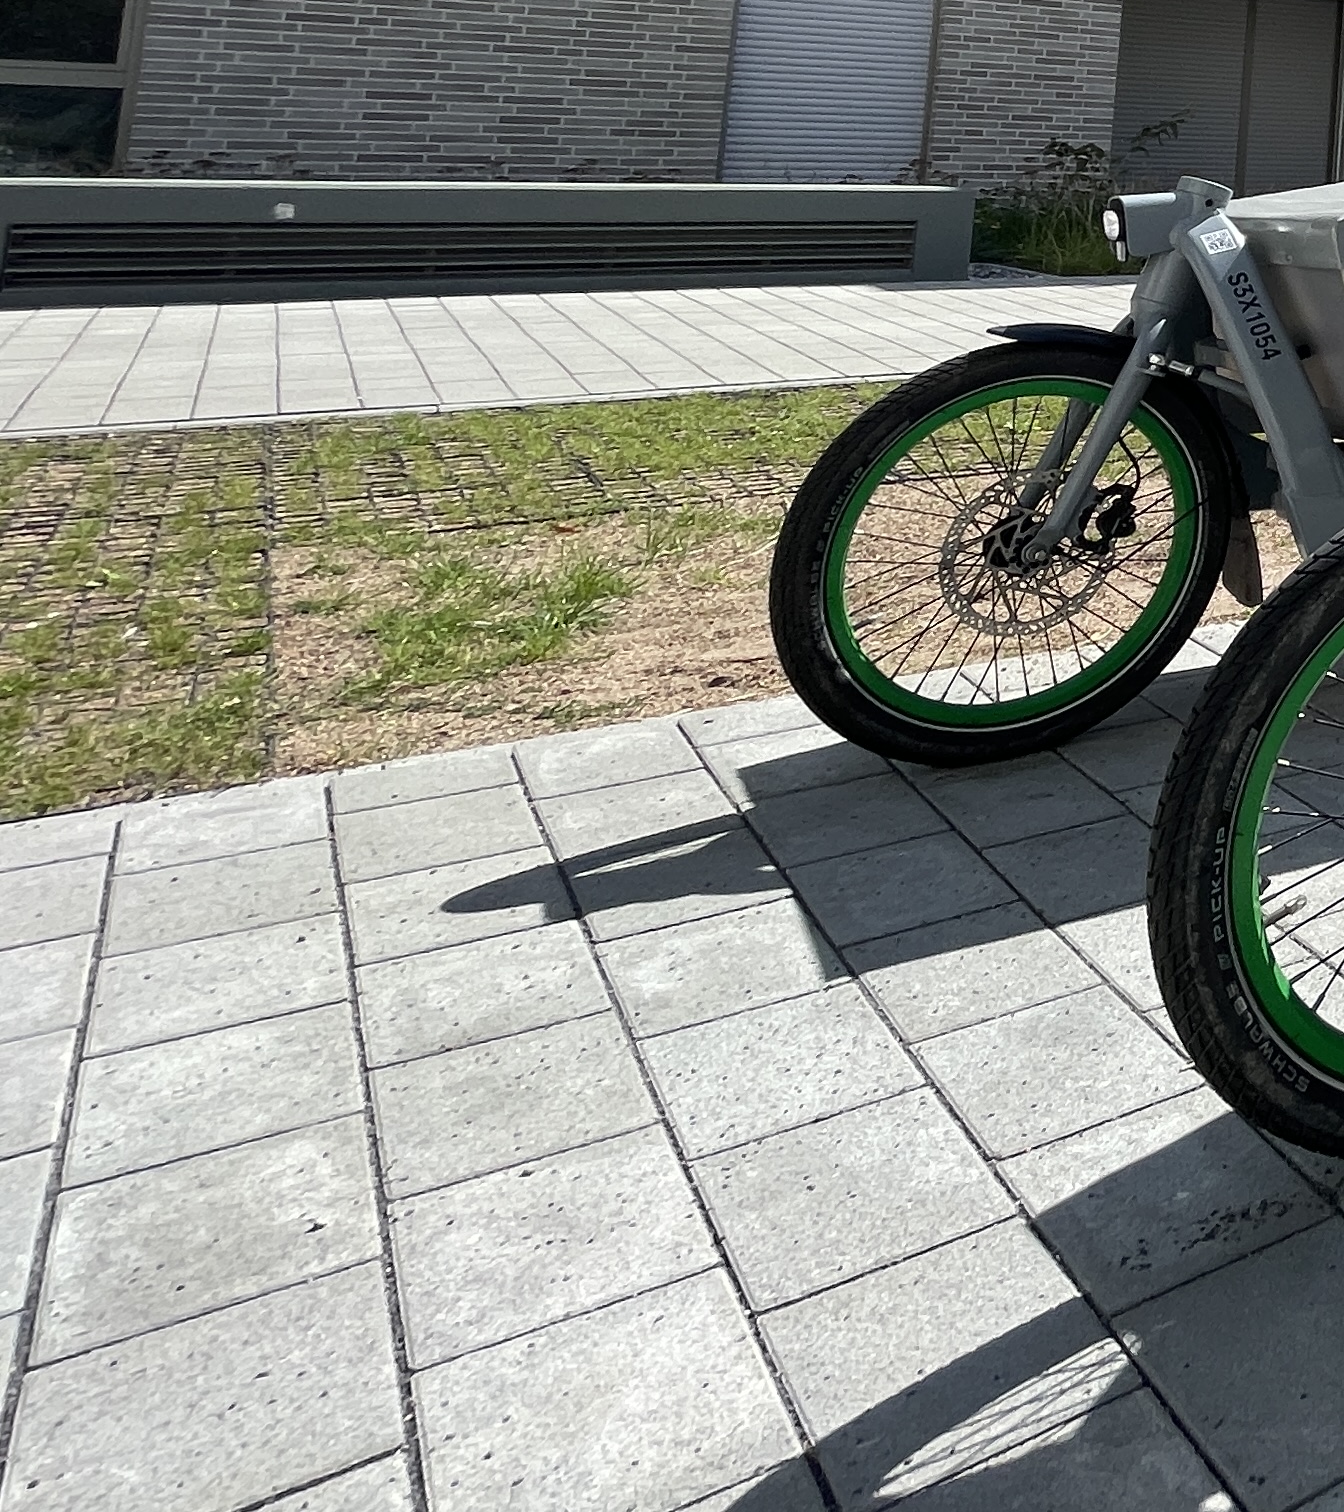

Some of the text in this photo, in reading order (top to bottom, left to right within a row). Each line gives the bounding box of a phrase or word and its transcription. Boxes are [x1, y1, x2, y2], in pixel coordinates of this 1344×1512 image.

[1227, 271, 1283, 360] S3X1054
[1213, 826, 1226, 944] PICK-UP
[1225, 980, 1311, 1093] SCHWALBE
